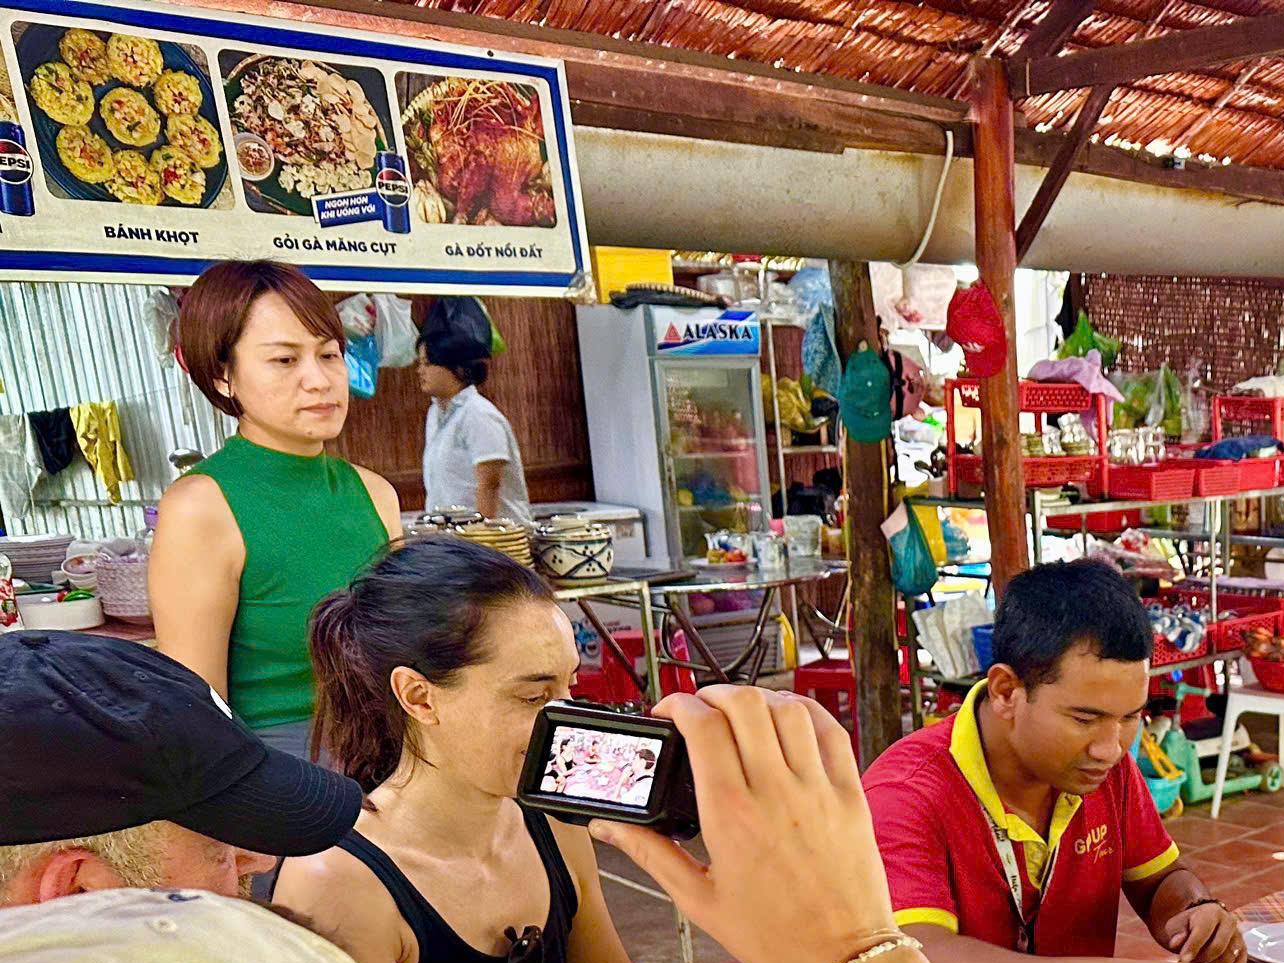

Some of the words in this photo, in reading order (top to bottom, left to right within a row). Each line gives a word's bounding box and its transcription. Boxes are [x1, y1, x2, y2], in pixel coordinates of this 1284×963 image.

[0, 156, 30, 169] EPSI
[378, 181, 409, 194] PEPSI
[324, 198, 349, 209] NGON
[321, 210, 336, 220] KHI
[104, 223, 152, 240] BÁNH
[155, 229, 199, 246] KHỌT
[273, 233, 299, 250] GỎI
[302, 236, 323, 250] GÀ
[325, 237, 368, 253] MĂNG
[370, 242, 397, 256] CỤT
[445, 242, 464, 256] GÀ
[466, 242, 492, 257] ĐỐT
[520, 242, 544, 258] ĐẤT
[684, 322, 753, 340] ALASKA
